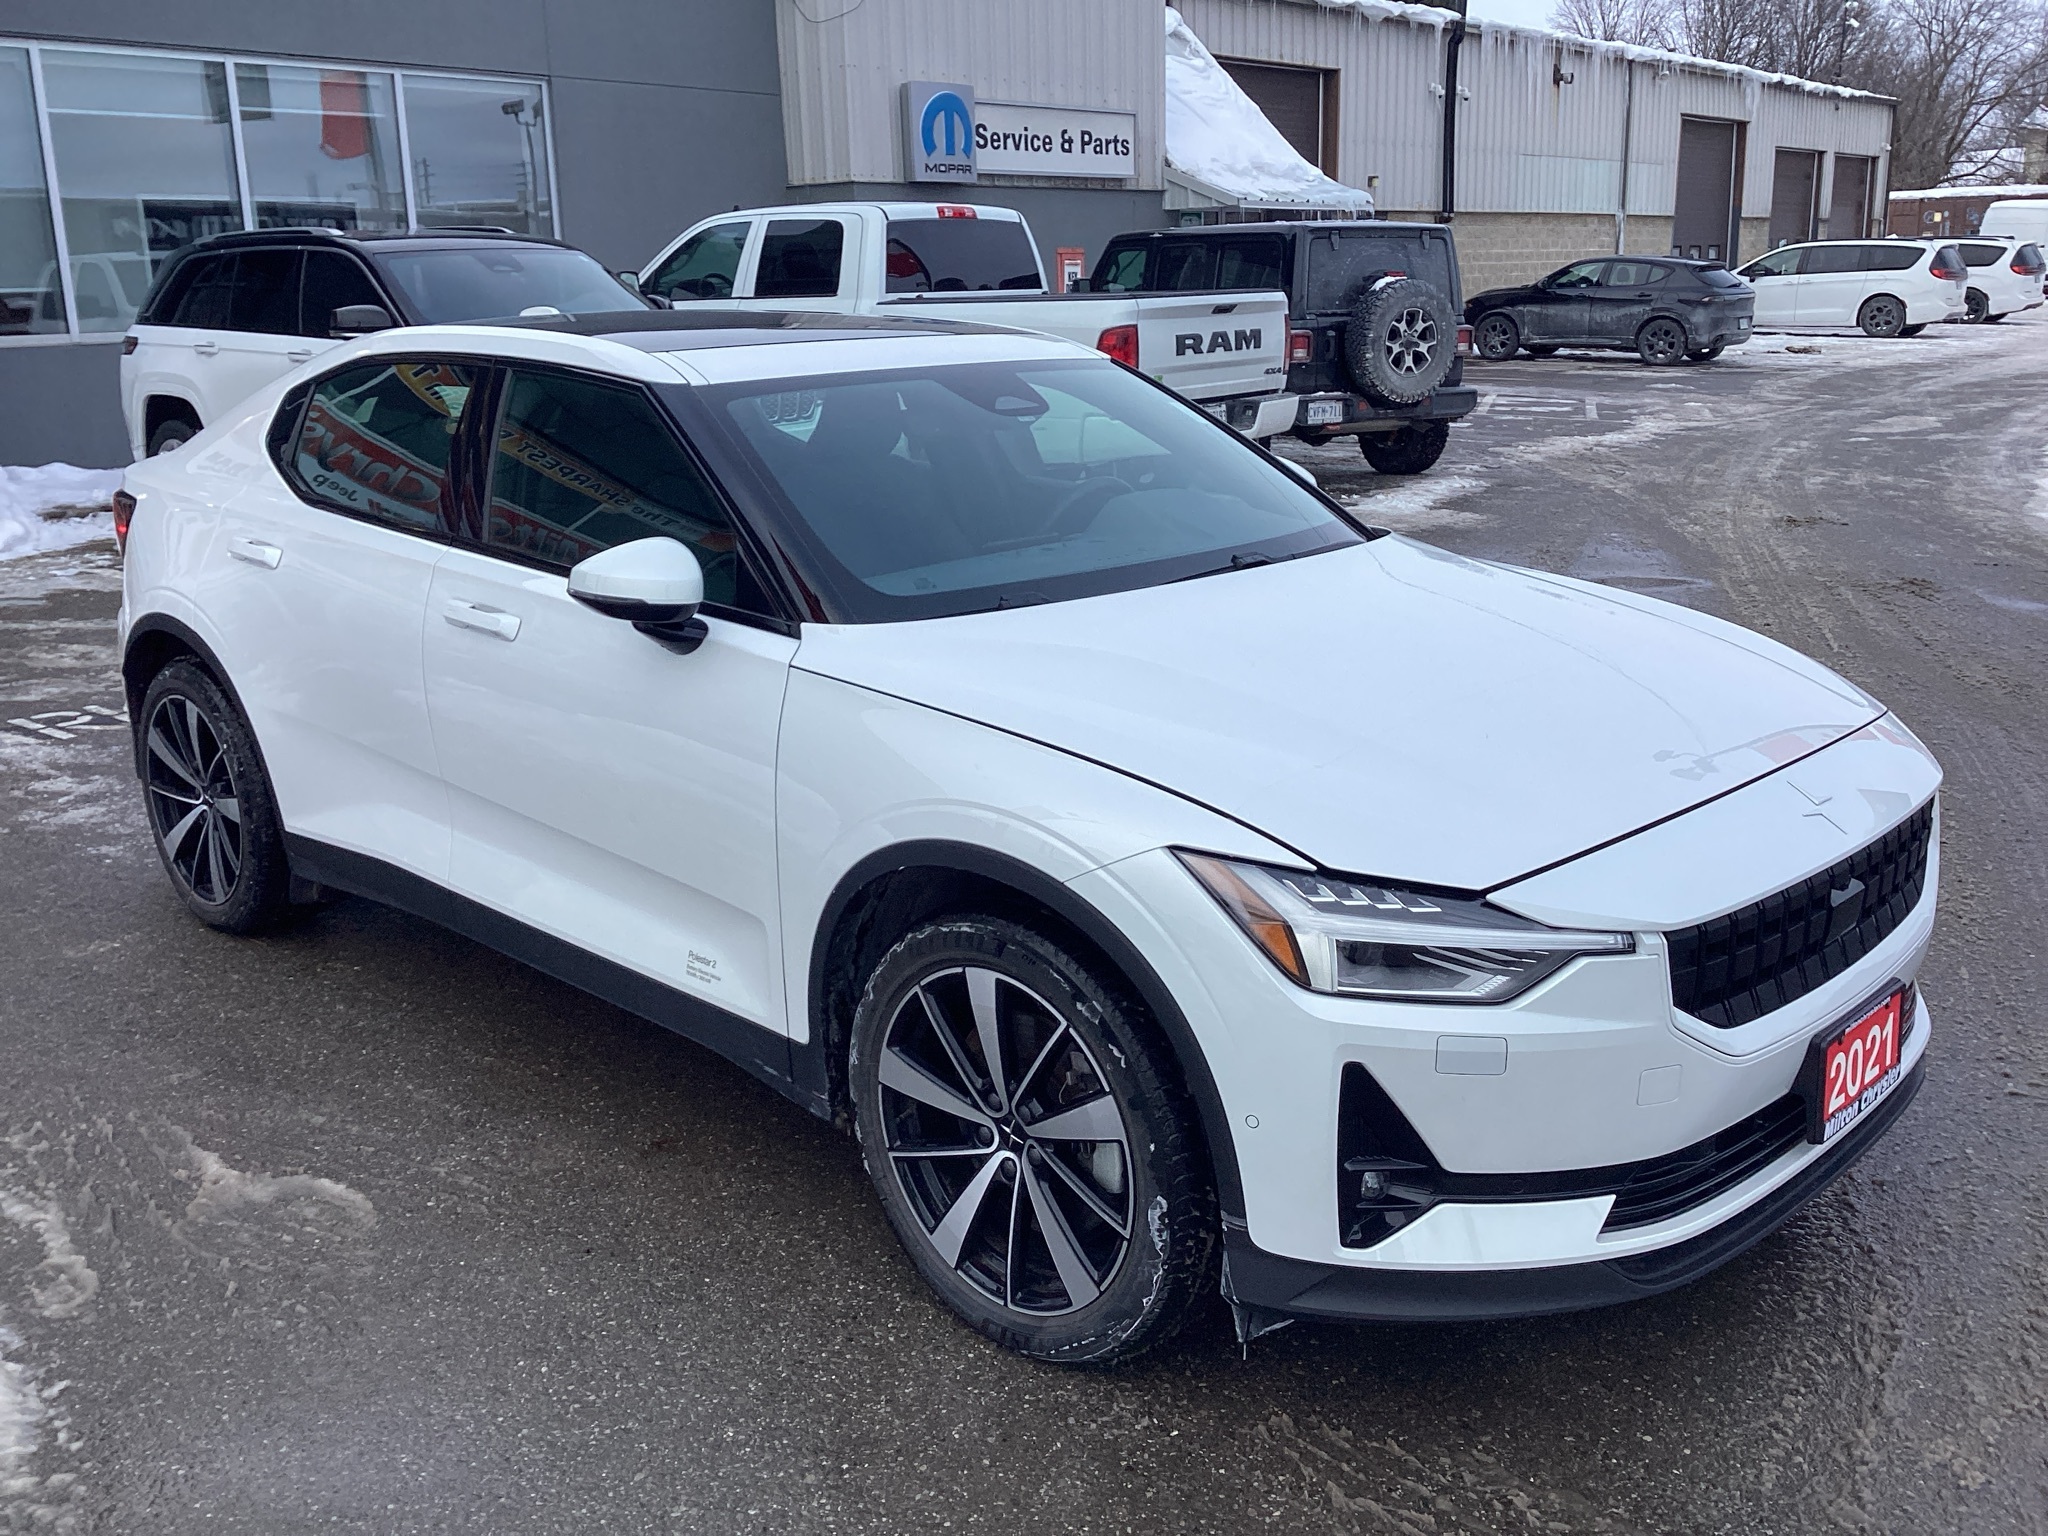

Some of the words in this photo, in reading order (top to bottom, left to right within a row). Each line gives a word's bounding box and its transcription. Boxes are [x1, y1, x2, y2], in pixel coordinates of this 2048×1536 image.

[975, 123, 1053, 152] Service
[1061, 129, 1073, 153] &
[1080, 130, 1130, 156] Parts
[924, 163, 972, 174] MOPAR
[1175, 328, 1262, 356] RAM
[1828, 1011, 1894, 1115] 2021
[1824, 1100, 1860, 1141] Milton
[1861, 1064, 1900, 1110] Chrysler
